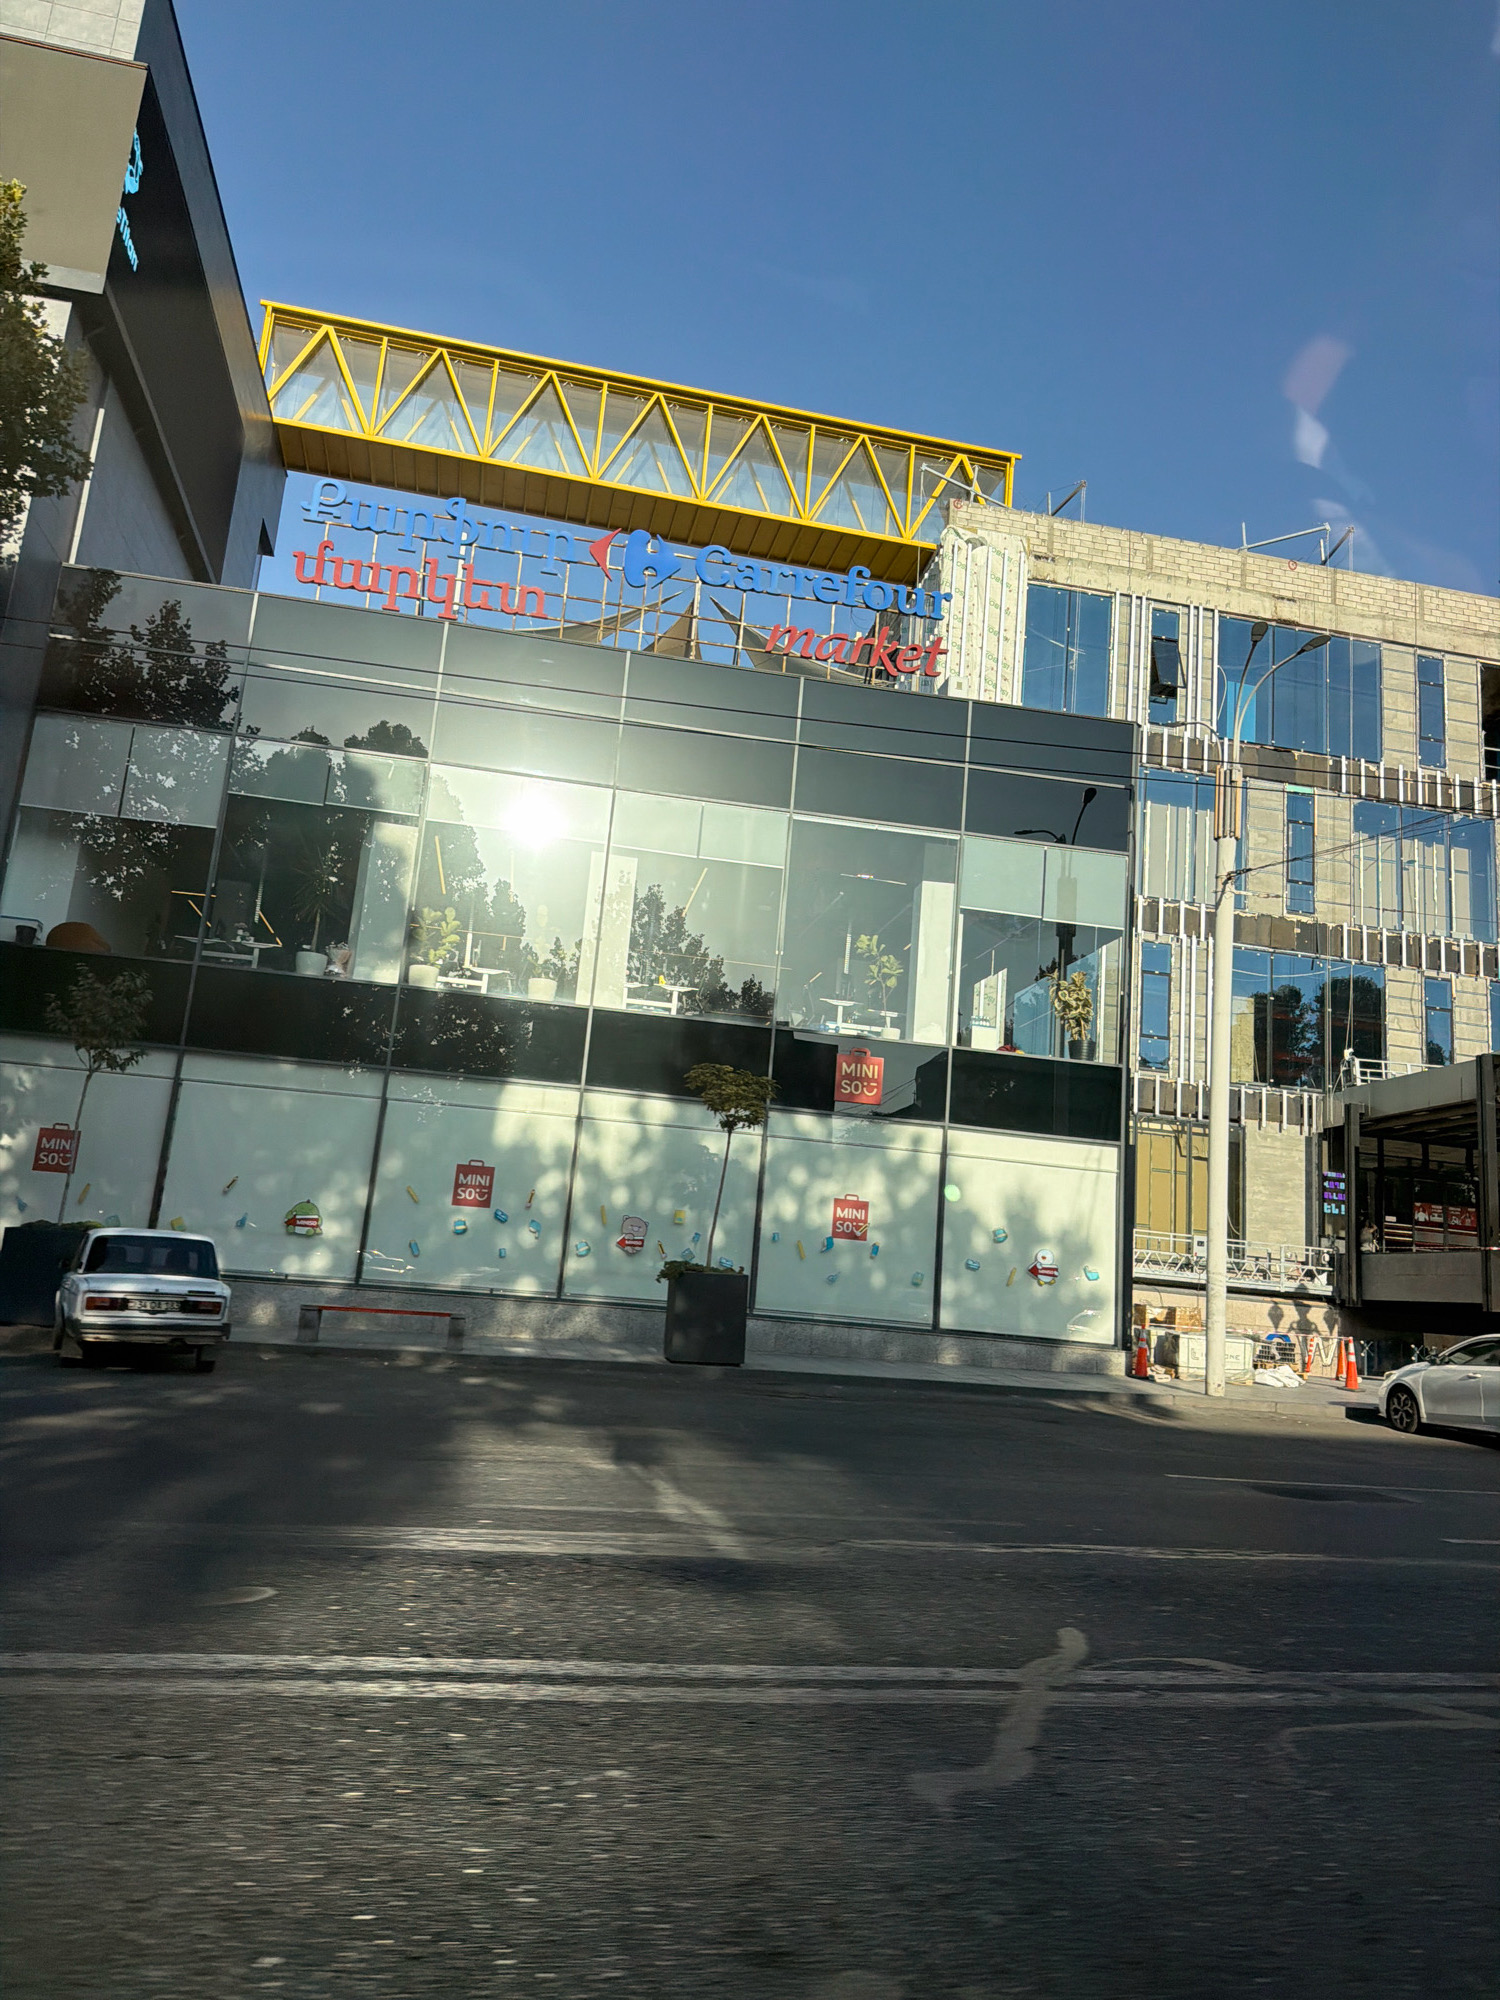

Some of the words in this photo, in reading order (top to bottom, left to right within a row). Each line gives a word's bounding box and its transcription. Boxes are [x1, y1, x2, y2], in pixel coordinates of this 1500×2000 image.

[300, 479, 576, 576] Քարֆուր
[292, 540, 548, 620] մարկետ
[694, 544, 953, 621] Carrefour
[764, 624, 949, 677] market
[841, 1061, 878, 1079] MINI
[840, 1079, 862, 1095] SO
[40, 1136, 73, 1150] MIN
[458, 1173, 490, 1186] MINI
[456, 1187, 475, 1200] SO
[836, 1206, 865, 1220] MINI
[835, 1220, 852, 1233] SO
